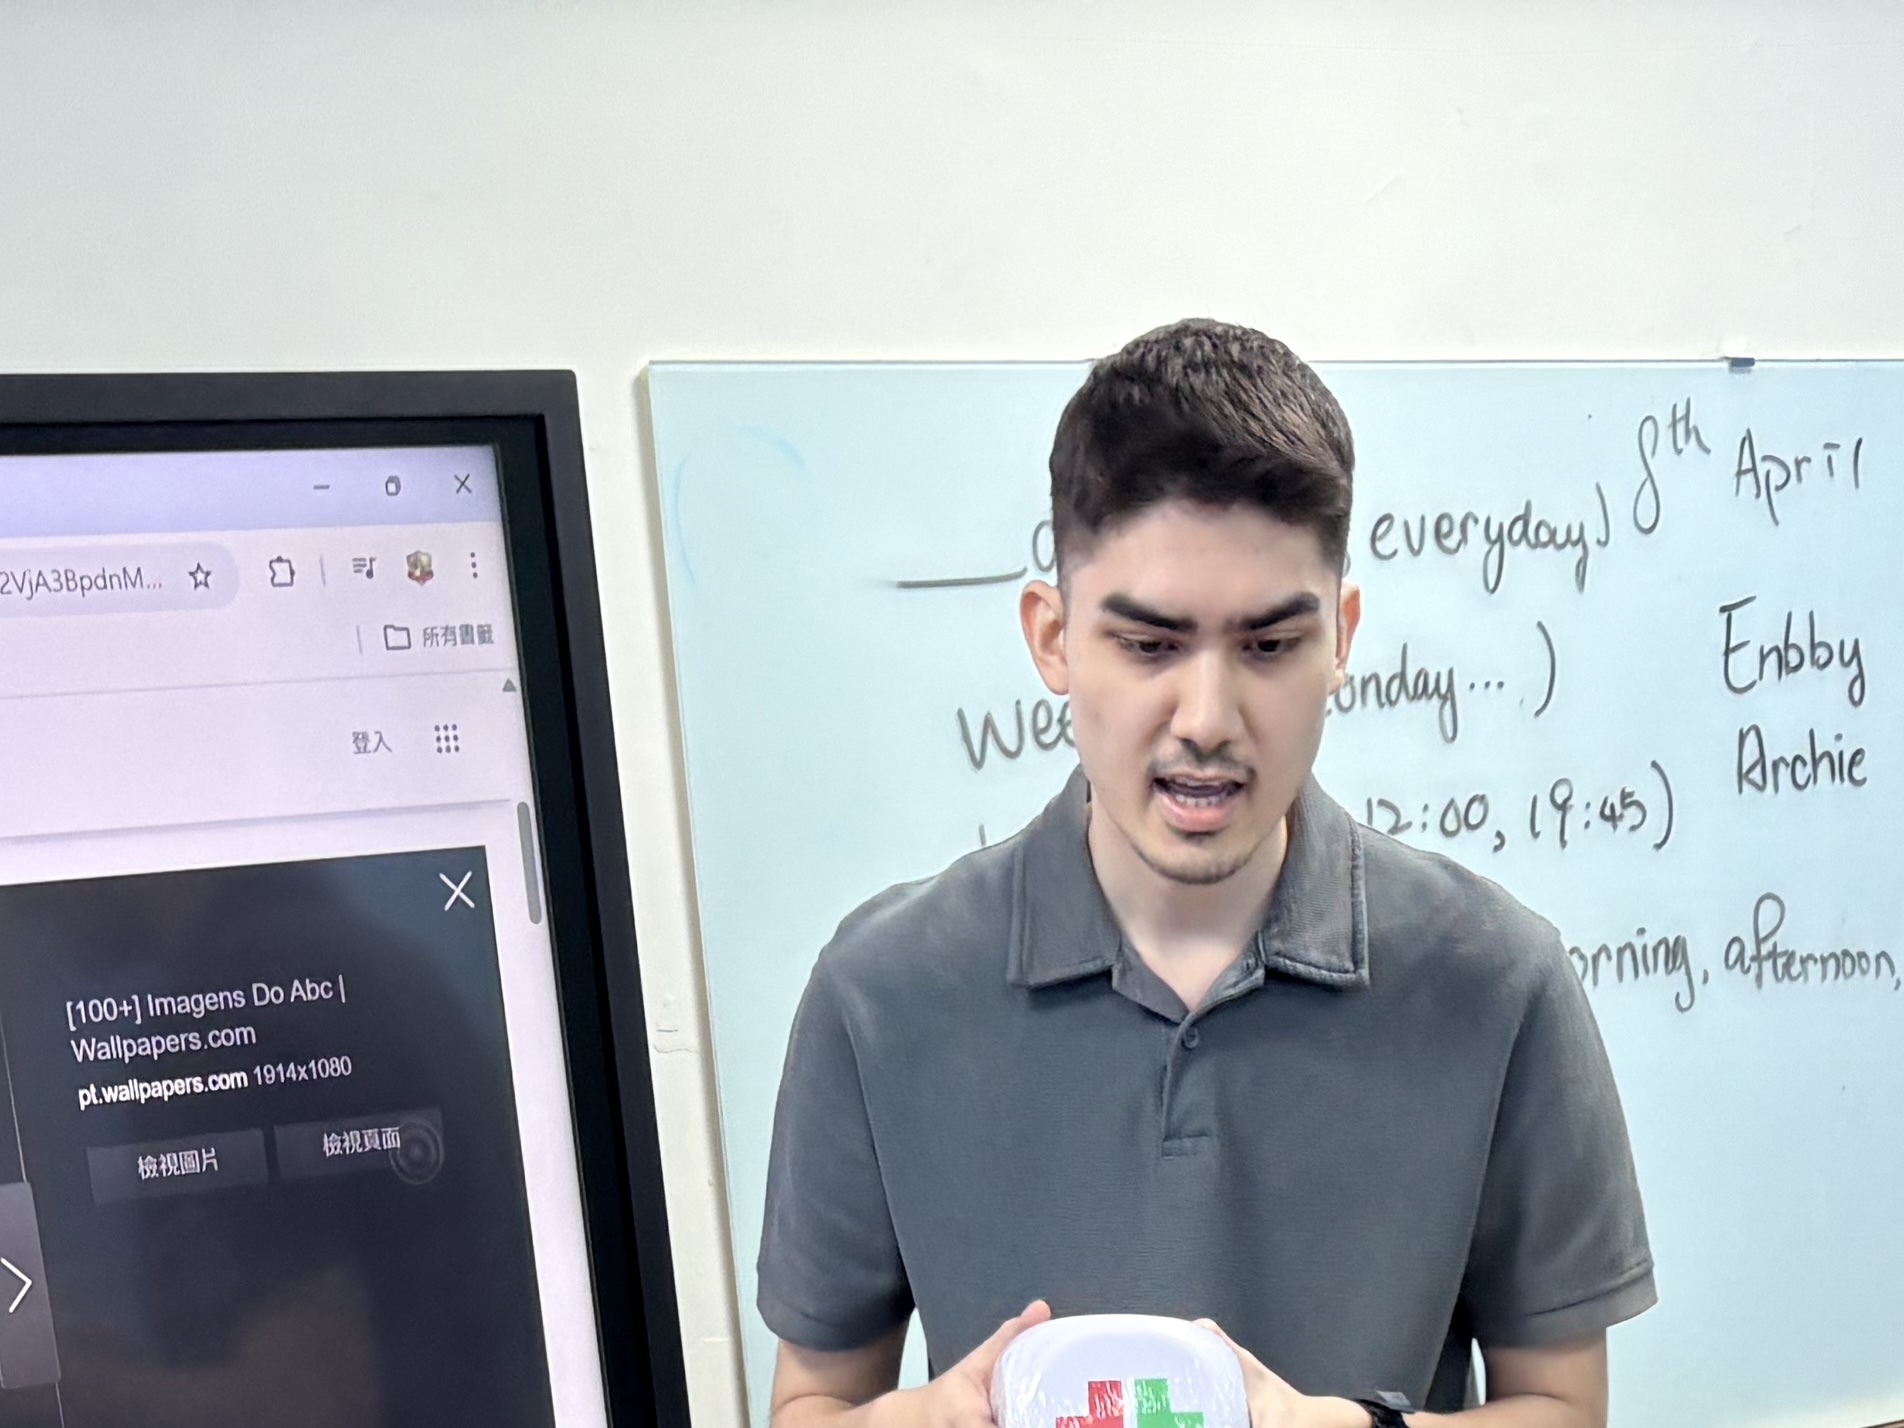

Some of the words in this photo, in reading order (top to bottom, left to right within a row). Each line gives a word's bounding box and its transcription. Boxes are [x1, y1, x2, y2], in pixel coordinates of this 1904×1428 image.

[1734, 427, 1863, 525] April
[422, 624, 494, 650] 所有書籤
[351, 730, 392, 756] 登入
[1737, 723, 1868, 794] Archie
[1570, 927, 1709, 1012] orning,
[66, 995, 141, 1031] [100+]
[148, 988, 245, 1019] Imagens
[253, 984, 283, 1007] Do
[290, 978, 332, 1002] Abc
[71, 1024, 256, 1064] Wallpapers.com
[79, 1070, 247, 1110] pt.wallpapers.com
[253, 1056, 352, 1085] 1914x1080
